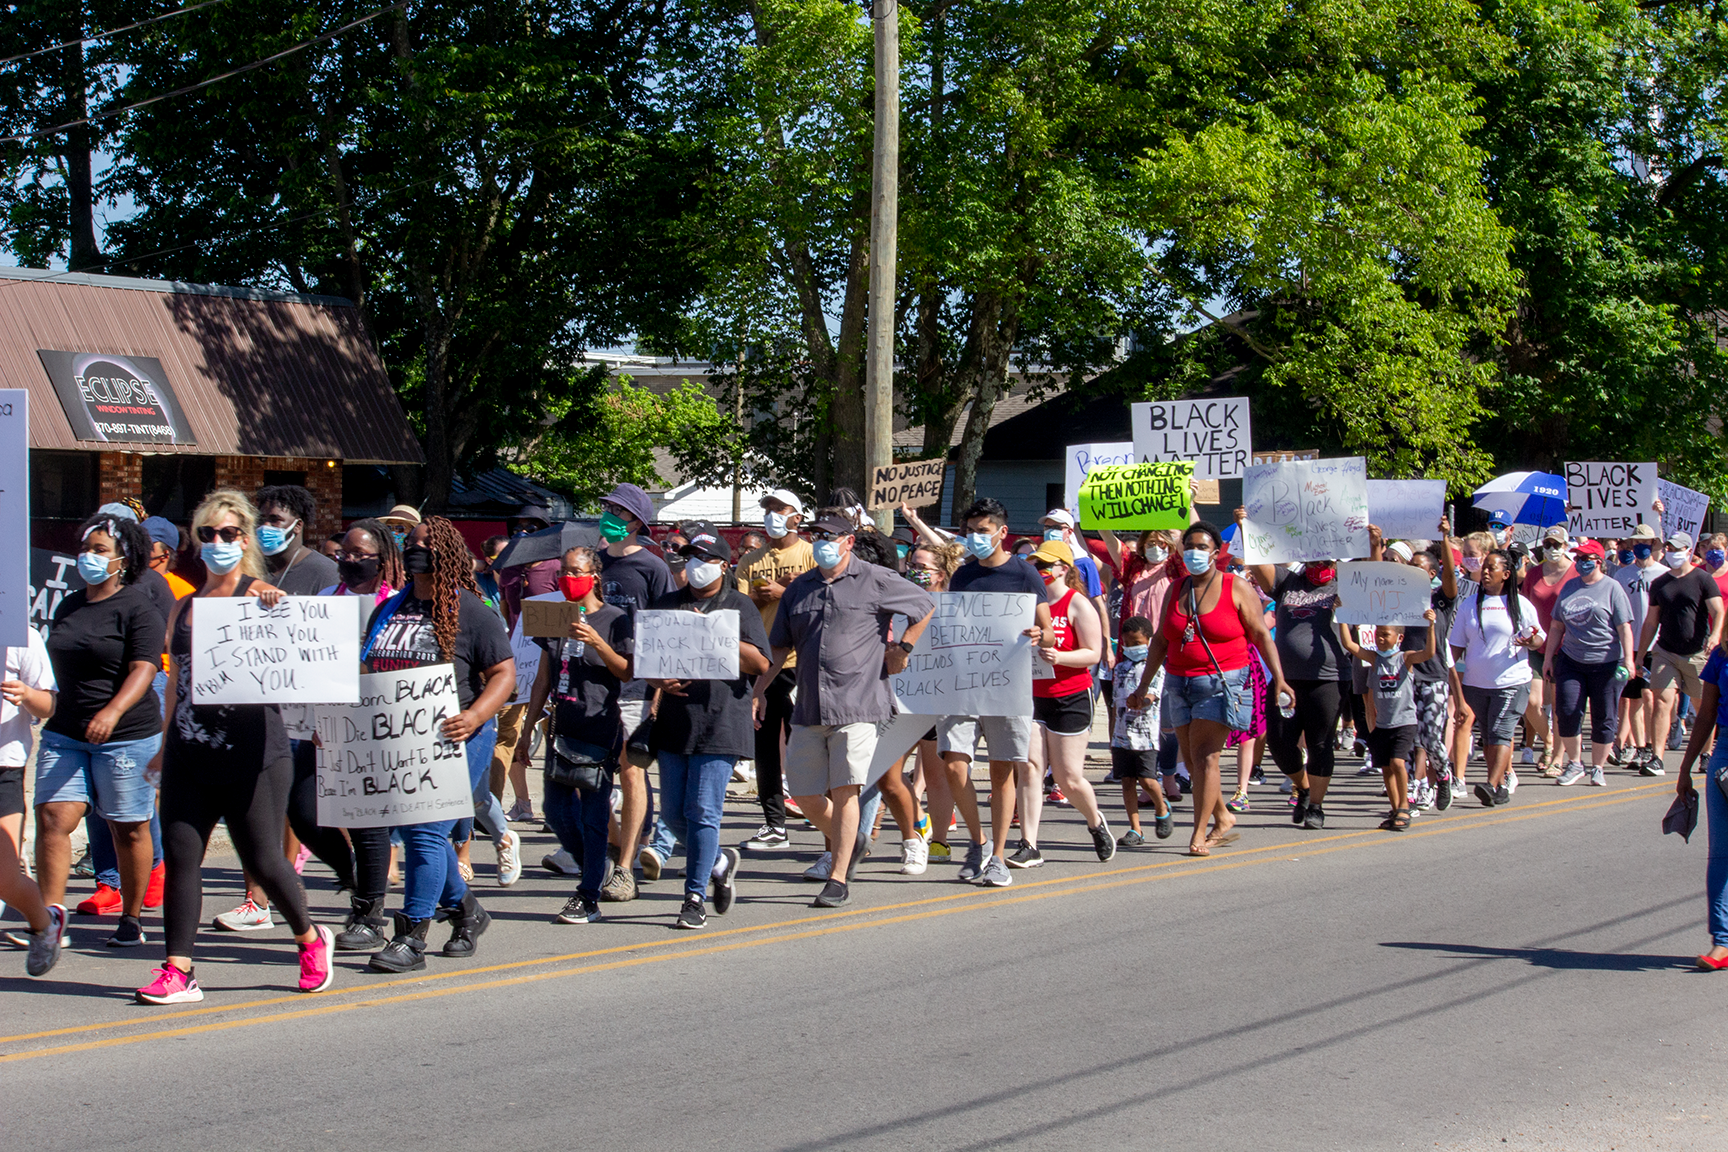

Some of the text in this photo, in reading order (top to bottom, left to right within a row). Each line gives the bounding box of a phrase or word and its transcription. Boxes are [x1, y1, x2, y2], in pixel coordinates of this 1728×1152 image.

[74, 375, 160, 406] ECLIPSE
[95, 405, 156, 416] WINDOW TINTING
[1150, 402, 1239, 430] BLACK
[1163, 428, 1238, 454] LIVES
[876, 462, 944, 484] NO JUSTICE
[1121, 463, 1194, 480] CHANGING
[1566, 462, 1642, 488] BLACK
[875, 480, 941, 505] NO PEACE
[1088, 476, 1182, 500] THEN NOTHING
[1534, 486, 1559, 496] 1920
[1567, 487, 1638, 510] LIVES
[1091, 501, 1133, 521] WILL
[1257, 480, 1338, 527] Black
[1677, 517, 1697, 533] BUT
[46, 555, 77, 591] I
[1351, 571, 1408, 592] My name is
[237, 601, 252, 622] I
[999, 593, 1029, 618] IS
[1369, 590, 1405, 612] MJ
[525, 605, 573, 627] BLM
[642, 614, 722, 630] EQUALITY
[217, 624, 233, 644] I
[239, 623, 279, 641] HEAR
[204, 644, 340, 670] I STAND WITH
[372, 660, 420, 672] #UNITY
[416, 652, 437, 661] 2019
[659, 655, 732, 674] MATTER
[902, 649, 1002, 673] ATINOS FOR
[394, 674, 458, 702] BLACK
[895, 669, 1011, 698] BLACK LIVES
[342, 716, 368, 744] Die
[372, 705, 448, 741] BLACK
[347, 749, 377, 774] Don't
[417, 748, 429, 765] To
[432, 741, 463, 761] DIE
[339, 779, 357, 797] I'm
[362, 768, 439, 797] BLACK
[401, 800, 433, 814] DEATH
